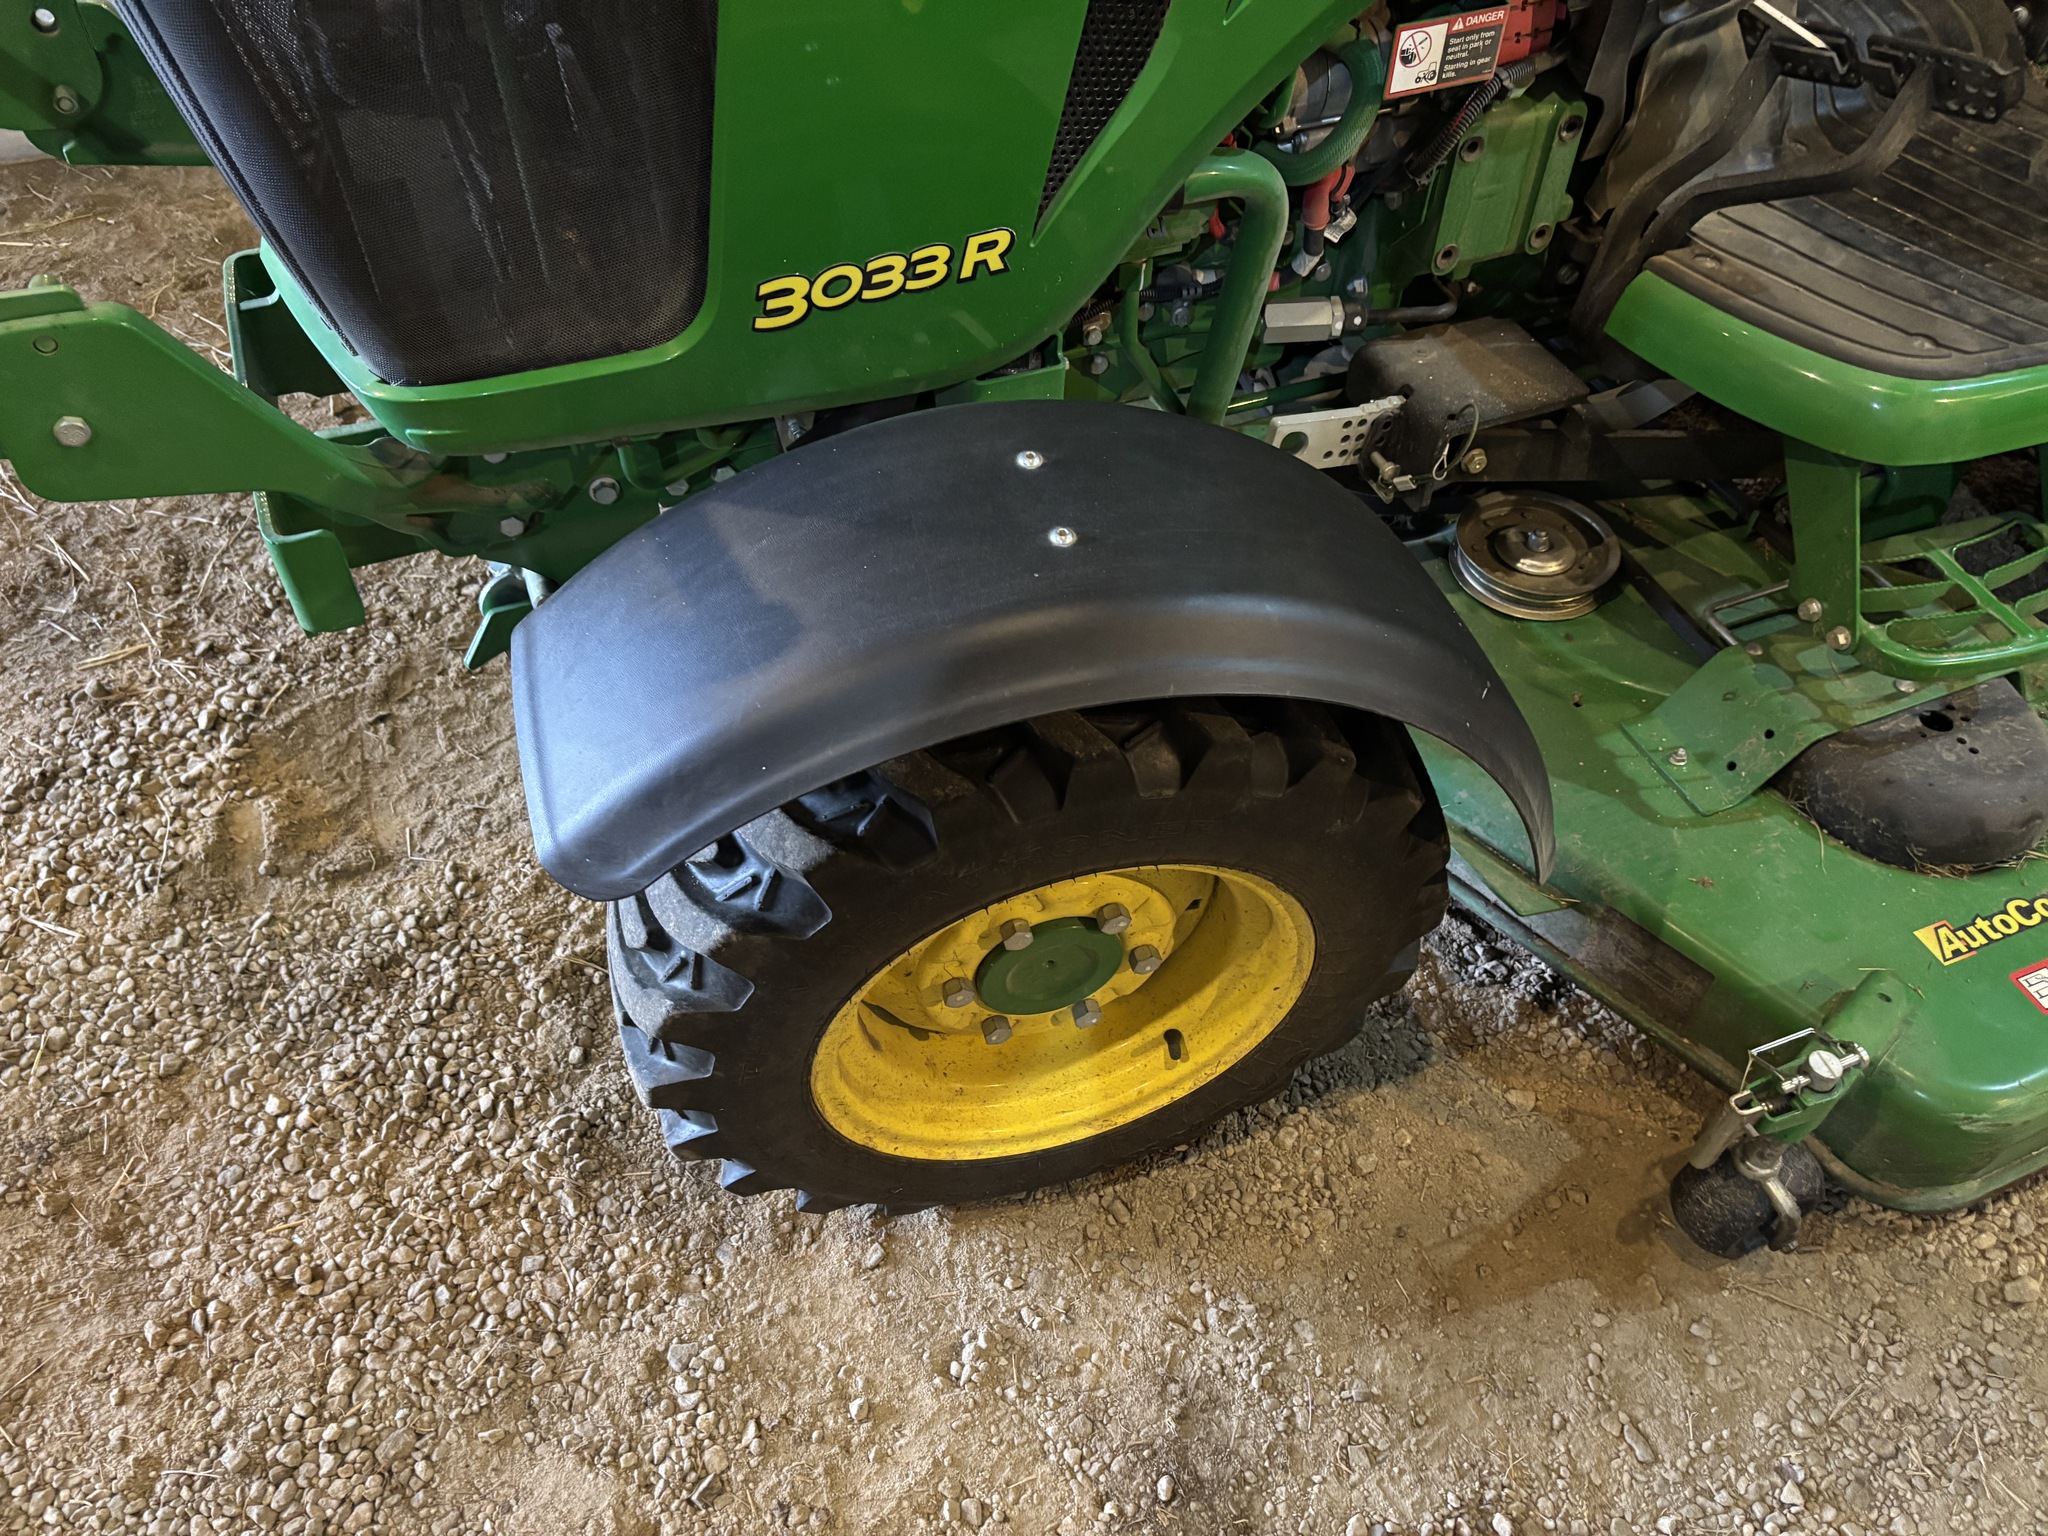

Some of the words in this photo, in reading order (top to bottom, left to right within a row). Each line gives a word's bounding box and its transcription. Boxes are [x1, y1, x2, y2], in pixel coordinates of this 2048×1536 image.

[1465, 10, 1505, 27] DANGER
[1449, 37, 1464, 45] Start
[1465, 33, 1479, 42] only
[1447, 45, 1461, 53] seat
[1469, 41, 1483, 50] park
[1446, 51, 1468, 60] neutral.
[1444, 62, 1468, 71] Starting
[1476, 56, 1491, 65] gear
